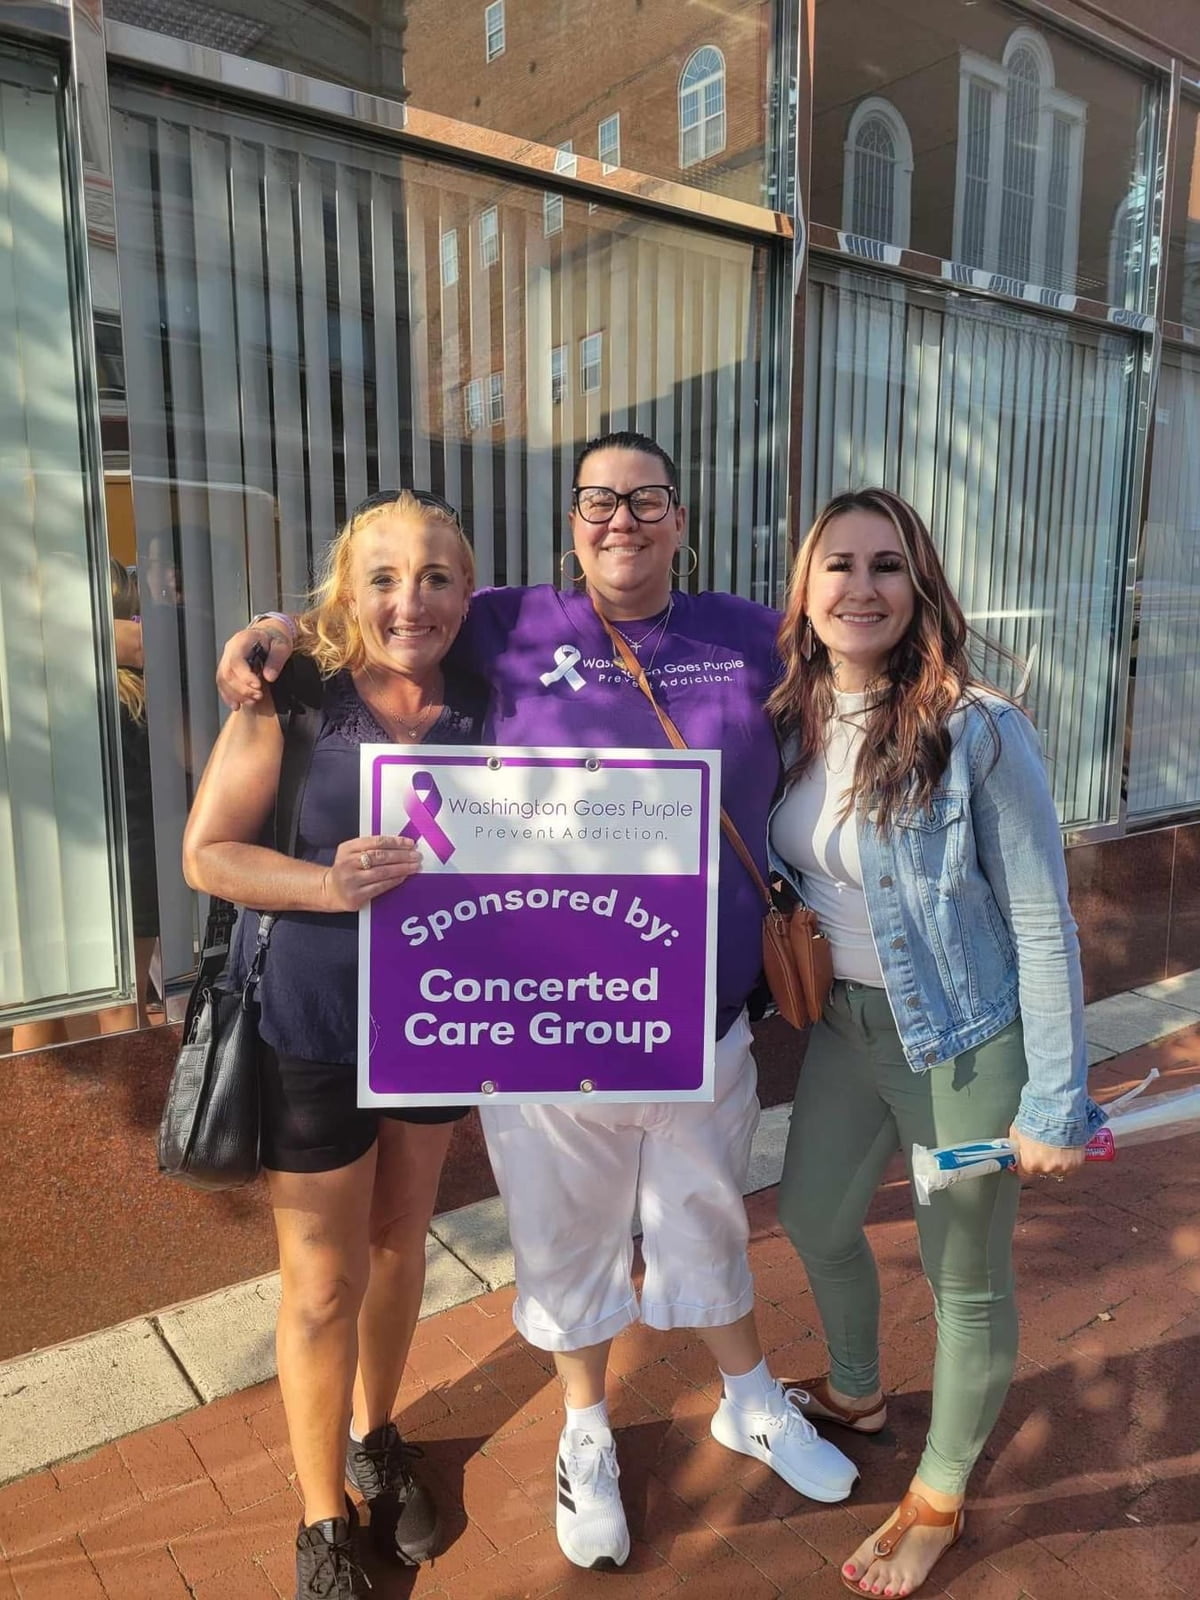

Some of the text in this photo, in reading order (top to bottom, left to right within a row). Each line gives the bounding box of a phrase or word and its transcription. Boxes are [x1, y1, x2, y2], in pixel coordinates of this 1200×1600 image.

[664, 663, 701, 673] Goes
[703, 659, 744, 671] Purple
[448, 798, 693, 820] Washington Goes Purple
[475, 826, 668, 840] Prevent Addiction.
[401, 888, 680, 946] Sponsored by:
[419, 967, 658, 1002] Concerted
[404, 1011, 672, 1053] Care Group
